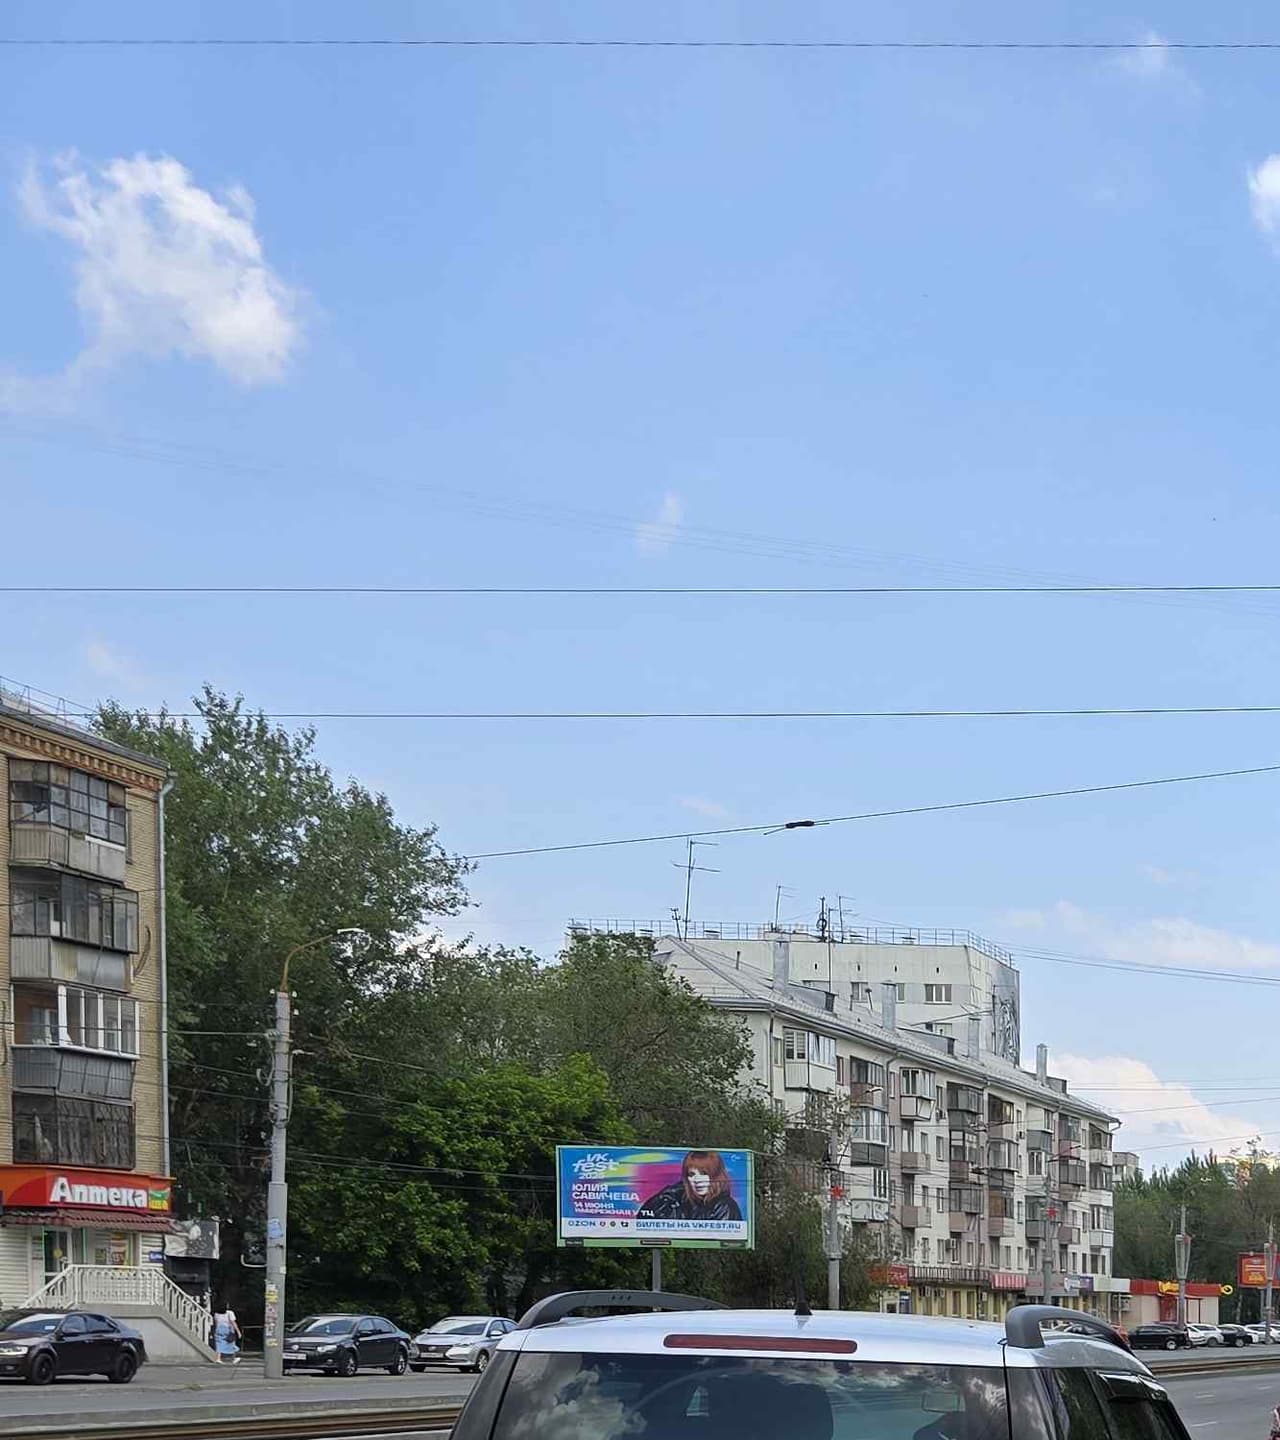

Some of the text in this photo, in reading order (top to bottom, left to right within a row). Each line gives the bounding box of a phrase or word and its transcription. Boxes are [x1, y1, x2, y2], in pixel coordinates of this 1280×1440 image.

[572, 1160, 620, 1173] fest
[50, 1176, 148, 1208] Аптека
[571, 1183, 609, 1192] ЮЛИЯ
[571, 1191, 640, 1201] САВИЧЕВА
